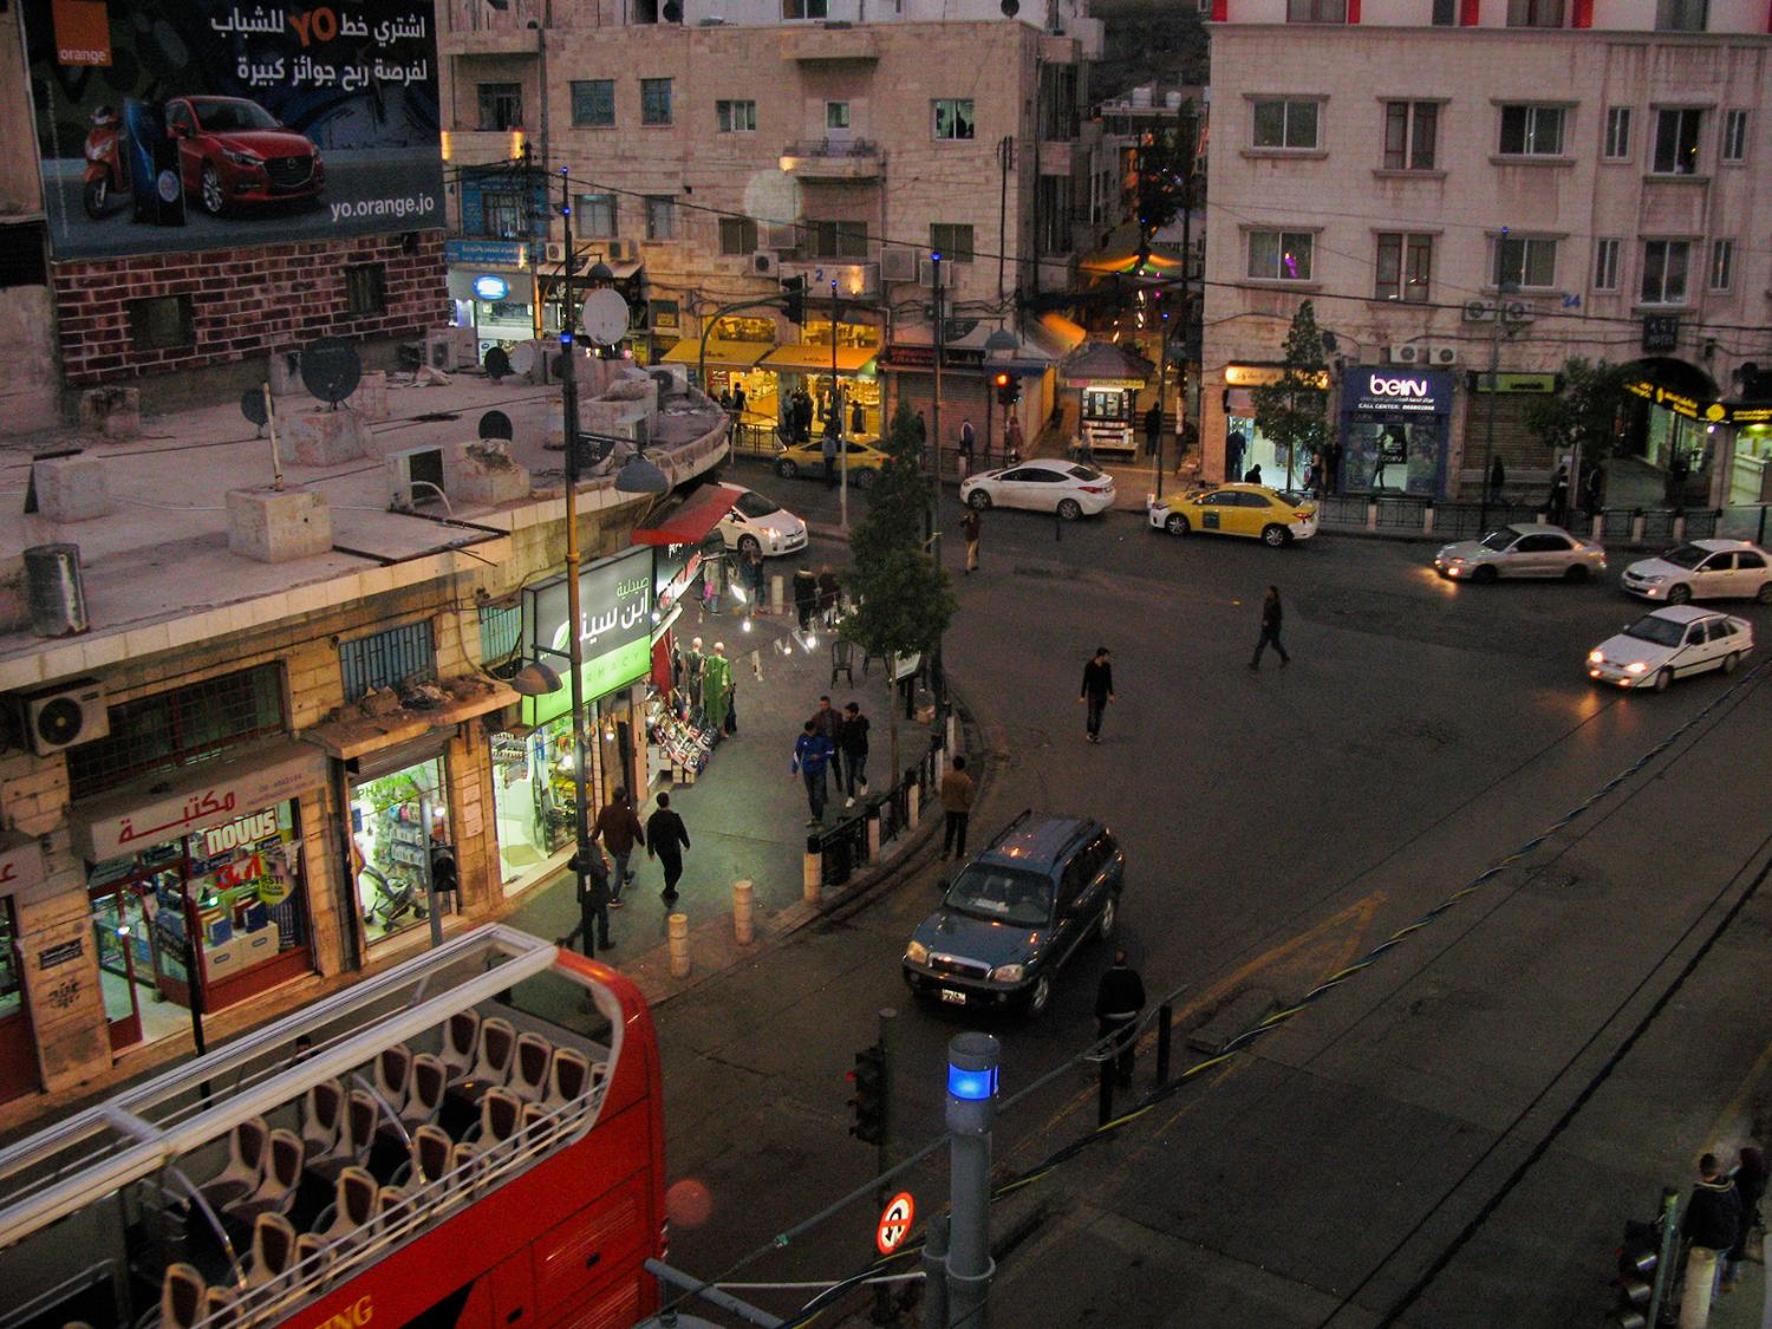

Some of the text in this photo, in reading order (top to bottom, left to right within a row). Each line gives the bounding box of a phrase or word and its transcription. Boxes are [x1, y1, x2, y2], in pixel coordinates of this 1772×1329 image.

[211, 5, 425, 47] اشتري خط YO للشباب
[59, 49, 107, 65] orange
[237, 55, 428, 91] لفرصة ربح جوائز كبيرة
[330, 192, 435, 222] yo.orange.jo
[616, 576, 649, 599] صيدلية
[620, 588, 648, 630] ابن
[118, 790, 237, 845] مكتبة
